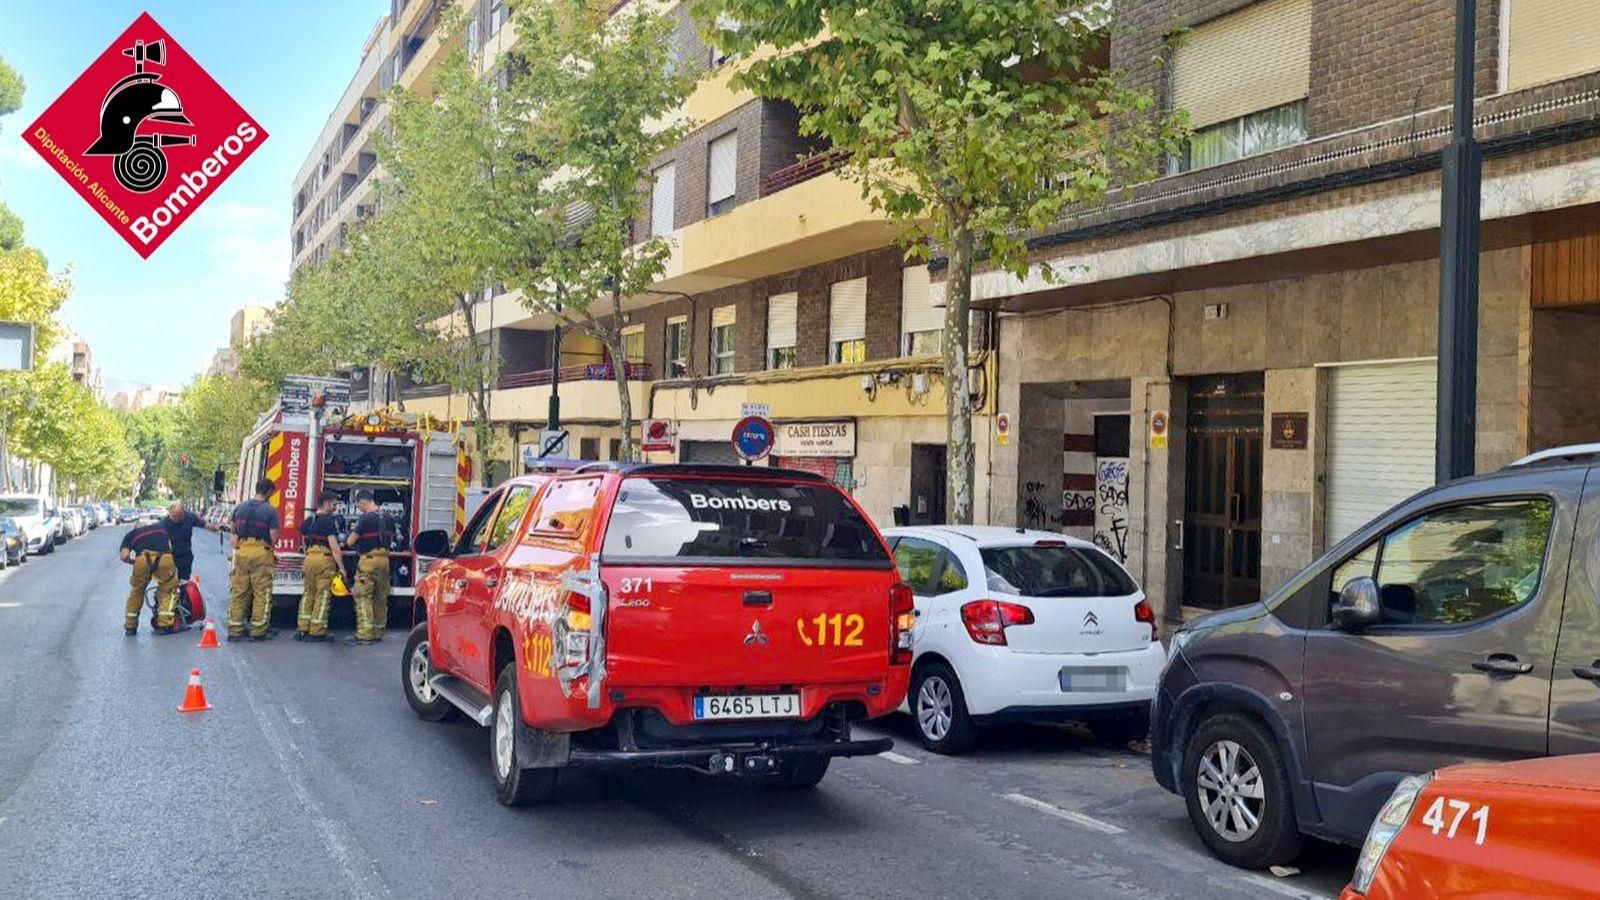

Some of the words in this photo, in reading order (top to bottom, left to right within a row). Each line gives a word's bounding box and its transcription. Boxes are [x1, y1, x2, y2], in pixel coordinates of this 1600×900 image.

[788, 425, 811, 438] CASH
[812, 424, 848, 438] FIESTAS
[285, 438, 301, 499] Bombers
[690, 493, 792, 512] Bombers
[620, 577, 652, 593] 371
[812, 613, 865, 647] 112
[531, 633, 553, 679] 112
[710, 696, 755, 716] 6465
[760, 696, 793, 714] LTJ
[1422, 796, 1490, 846] 471
